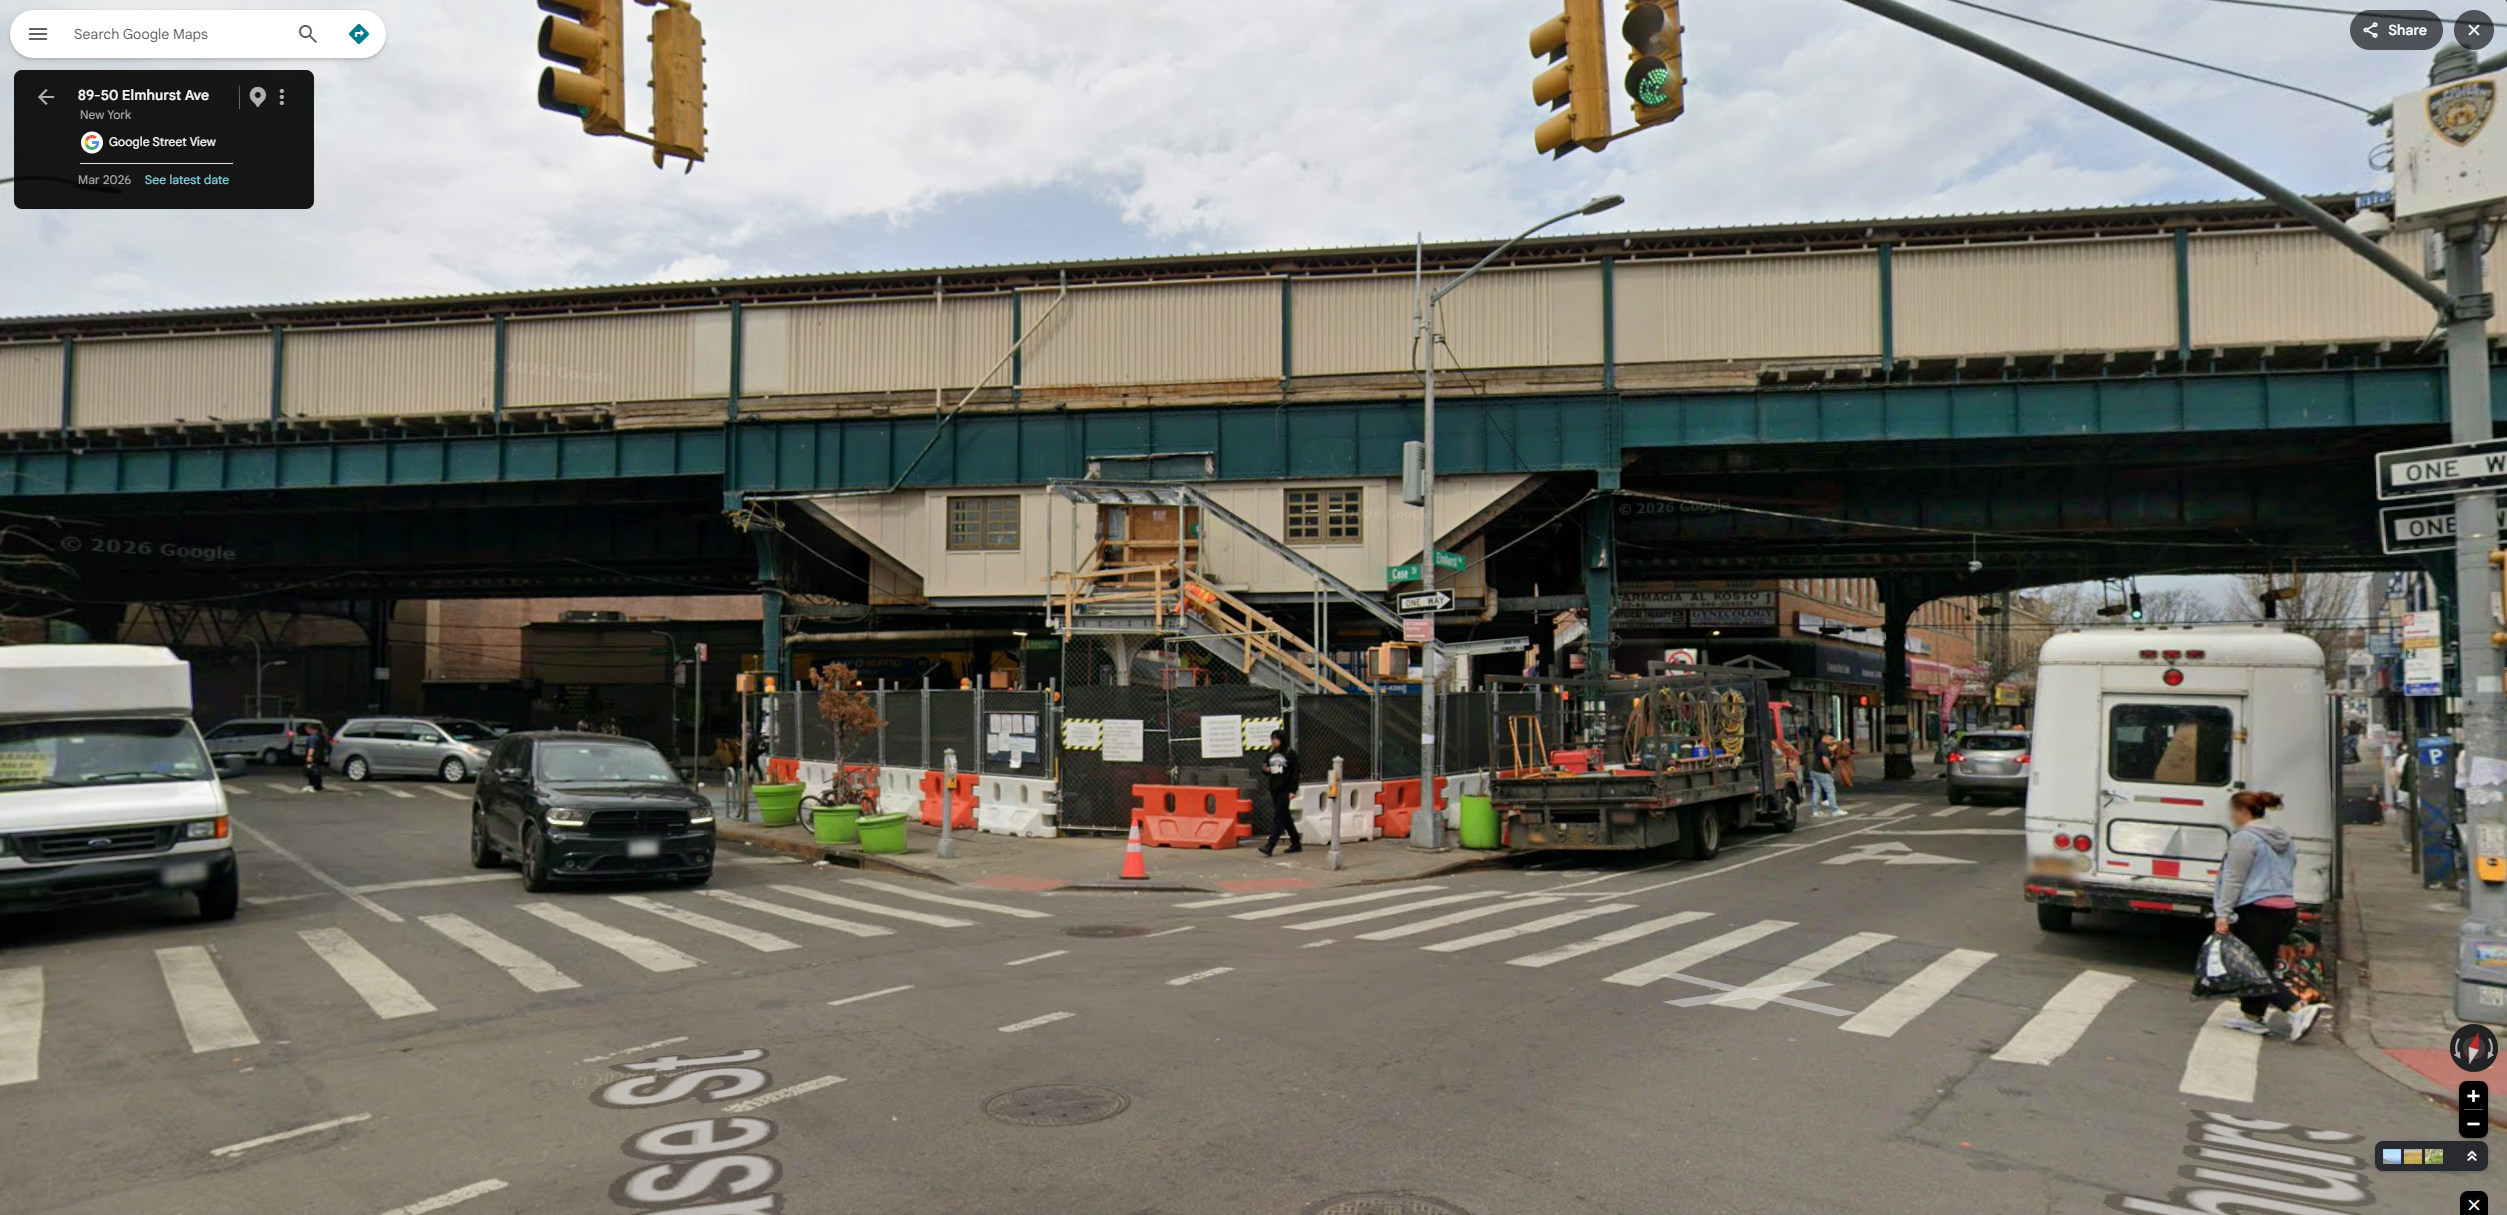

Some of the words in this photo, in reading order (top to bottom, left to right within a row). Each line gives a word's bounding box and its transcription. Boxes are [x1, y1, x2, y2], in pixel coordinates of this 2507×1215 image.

[2406, 460, 2459, 481] ONE
[2409, 516, 2456, 536] ONE
[1392, 568, 1409, 580] Case
[1405, 598, 1420, 608] ONE
[1427, 596, 1445, 605] WAY
[1691, 592, 1706, 601] AL
[1714, 591, 1759, 601] KOSTO
[1692, 608, 1771, 618] GYNECOLOGY
